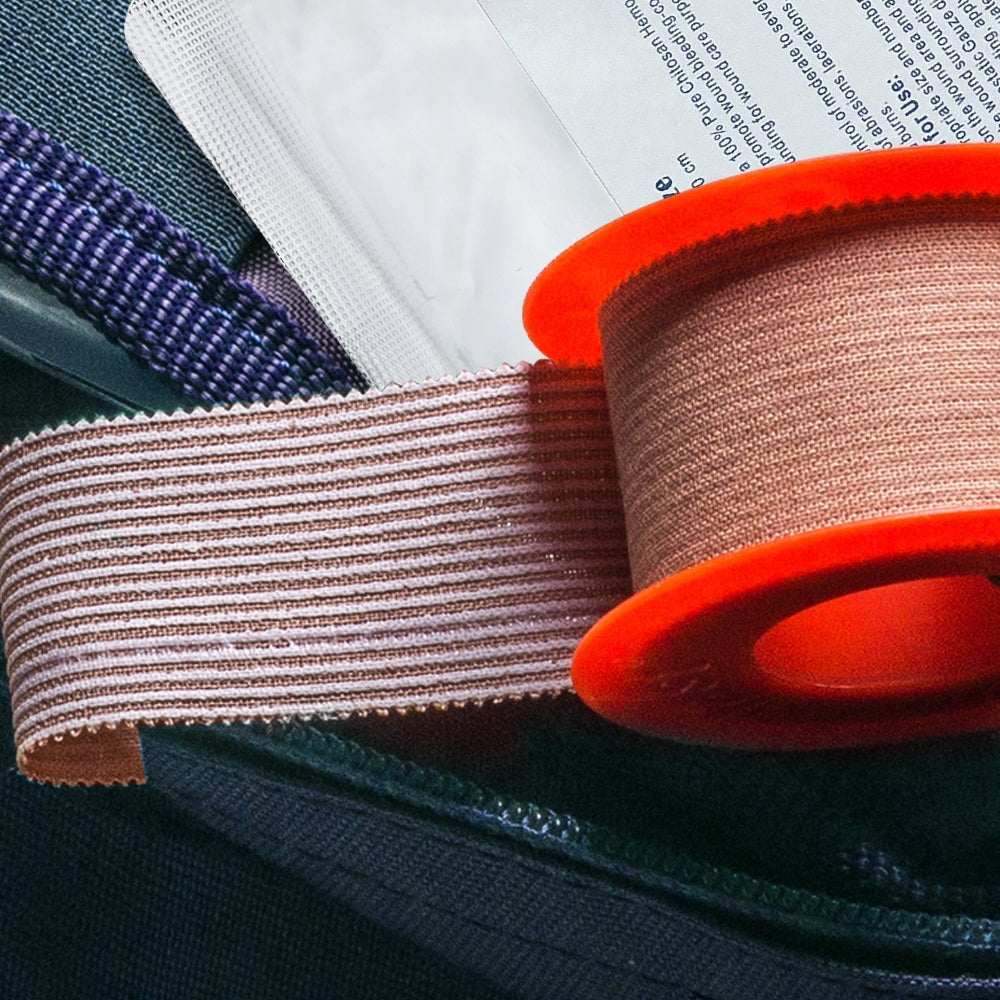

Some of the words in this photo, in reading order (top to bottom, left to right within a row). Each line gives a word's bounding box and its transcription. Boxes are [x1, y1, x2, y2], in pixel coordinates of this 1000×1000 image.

[887, 6, 914, 34] and
[942, 9, 977, 53] Gauze
[696, 30, 722, 61] care
[778, 31, 794, 50] to
[887, 41, 915, 69] and
[908, 31, 936, 63] area
[650, 35, 694, 94] Chitosan
[712, 58, 752, 104] wound
[788, 46, 837, 108] moderate
[909, 66, 934, 96] size
[926, 60, 966, 106] wound
[689, 92, 718, 127] Pure
[695, 69, 734, 115] wound
[832, 68, 883, 137] abrasions,
[885, 73, 920, 117] Use:
[957, 68, 997, 114] wound
[745, 102, 766, 124] for
[826, 105, 846, 122] of
[879, 100, 913, 145] burns.
[912, 114, 940, 143] for
[929, 93, 971, 143] ropriate
[960, 103, 982, 129] the
[708, 123, 742, 162] 100%
[729, 112, 775, 167] promote
[759, 119, 796, 167] unding
[837, 119, 868, 154] ntrol
[675, 151, 696, 174] cm
[737, 160, 751, 173] a
